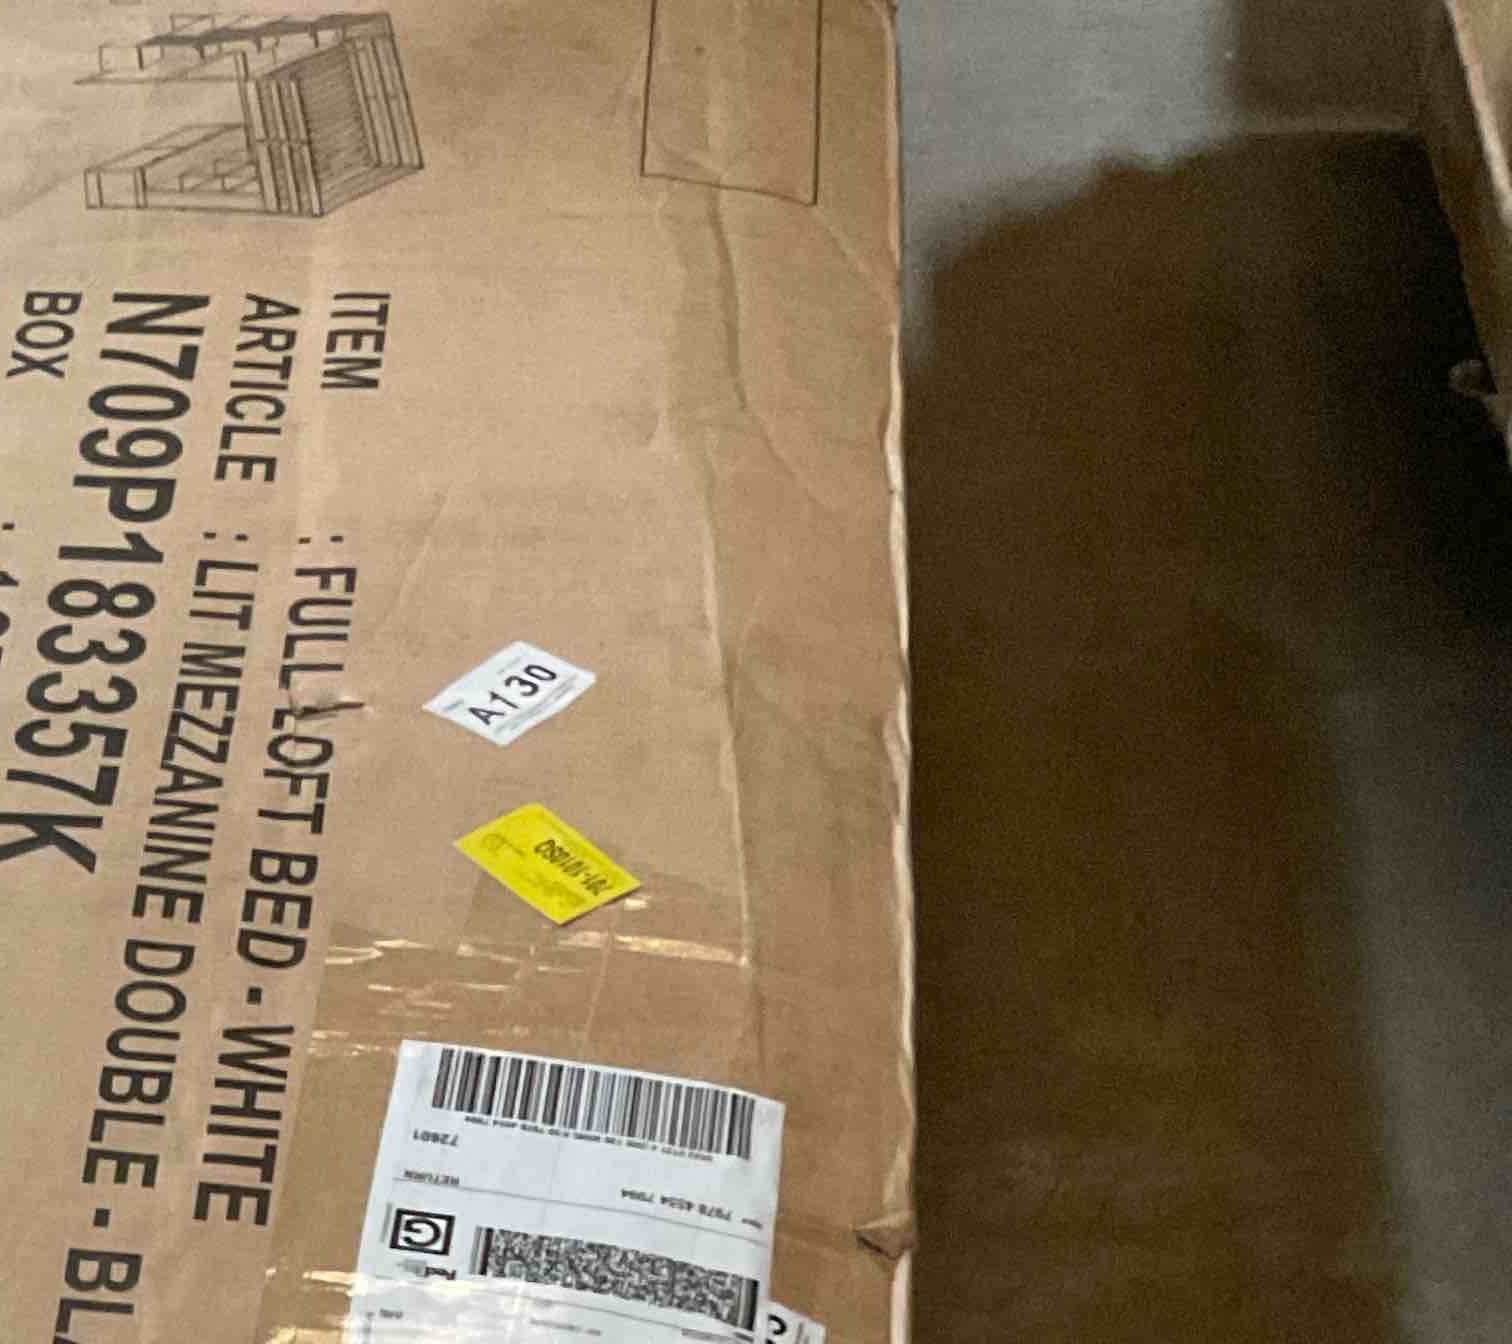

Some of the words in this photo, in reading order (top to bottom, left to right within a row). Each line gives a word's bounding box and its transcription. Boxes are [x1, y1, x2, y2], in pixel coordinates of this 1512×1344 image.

[7, 292, 82, 377] BOX
[216, 294, 300, 481] ARTICLE
[322, 293, 390, 388] ITEM
[190, 560, 258, 630] LIT
[280, 568, 356, 690] FULL
[468, 664, 557, 725] A130
[133, 643, 245, 923] MEZZANINE
[258, 702, 340, 834] LOFT
[238, 849, 318, 968] BED
[83, 940, 195, 1188] DOUBLE
[194, 1026, 294, 1225] WHITE
